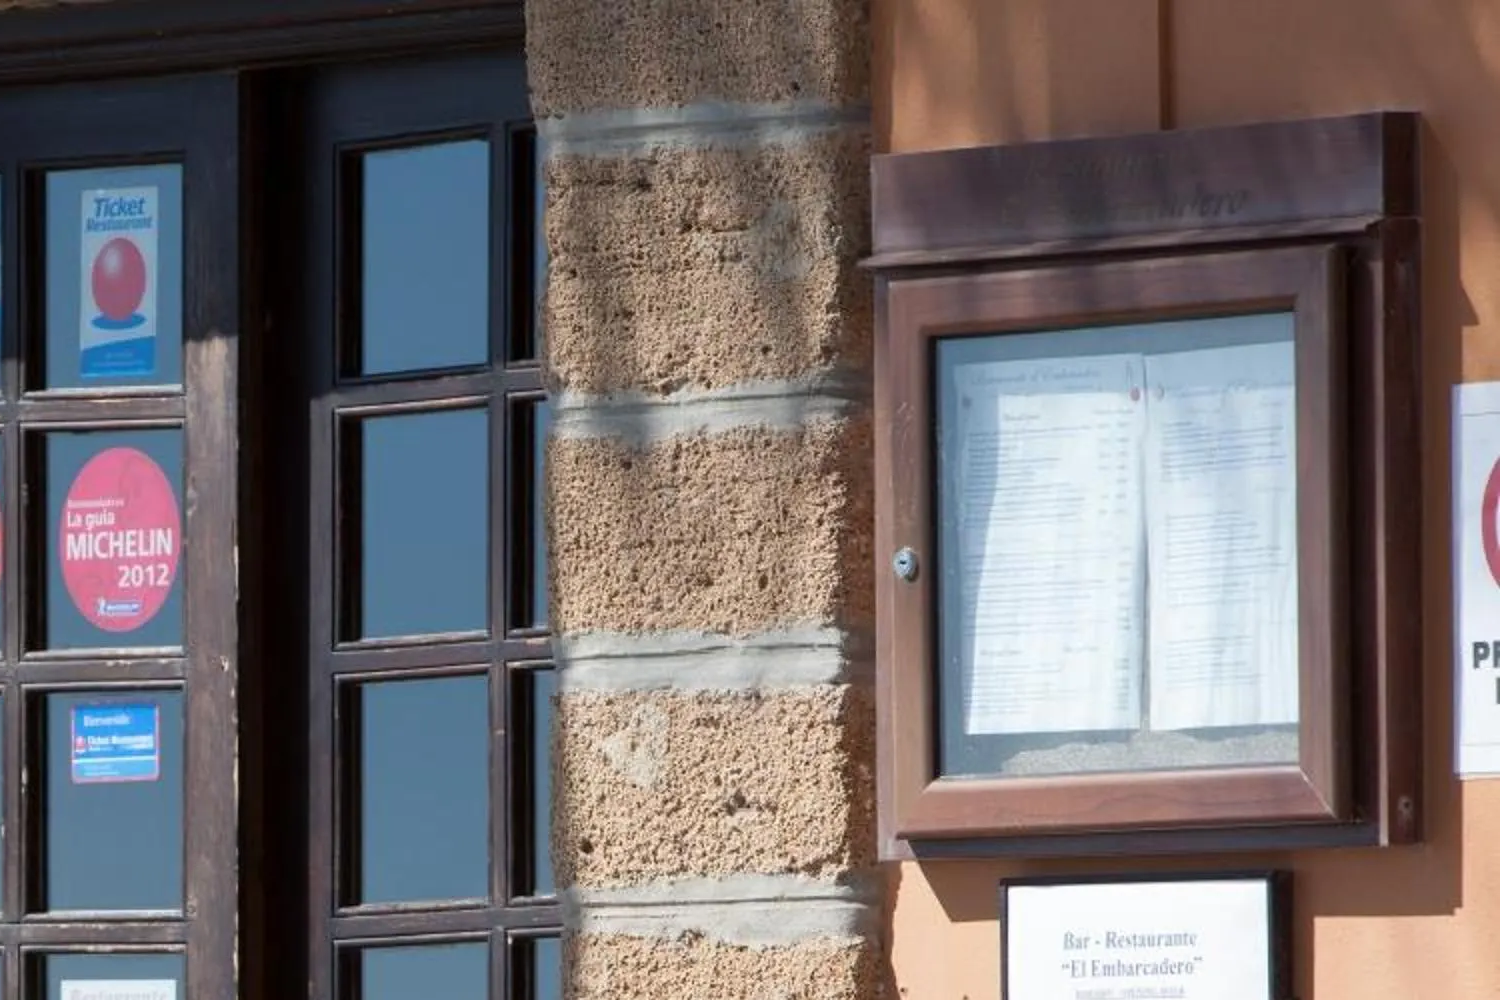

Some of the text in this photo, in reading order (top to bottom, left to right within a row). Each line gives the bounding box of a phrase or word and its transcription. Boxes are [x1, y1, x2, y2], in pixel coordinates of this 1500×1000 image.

[93, 196, 146, 217] Ticket
[67, 511, 82, 528] La
[67, 528, 173, 560] MICHELIN
[118, 564, 170, 588] 2012
[1063, 930, 1091, 950] Bar
[1105, 931, 1198, 950] Restaurante
